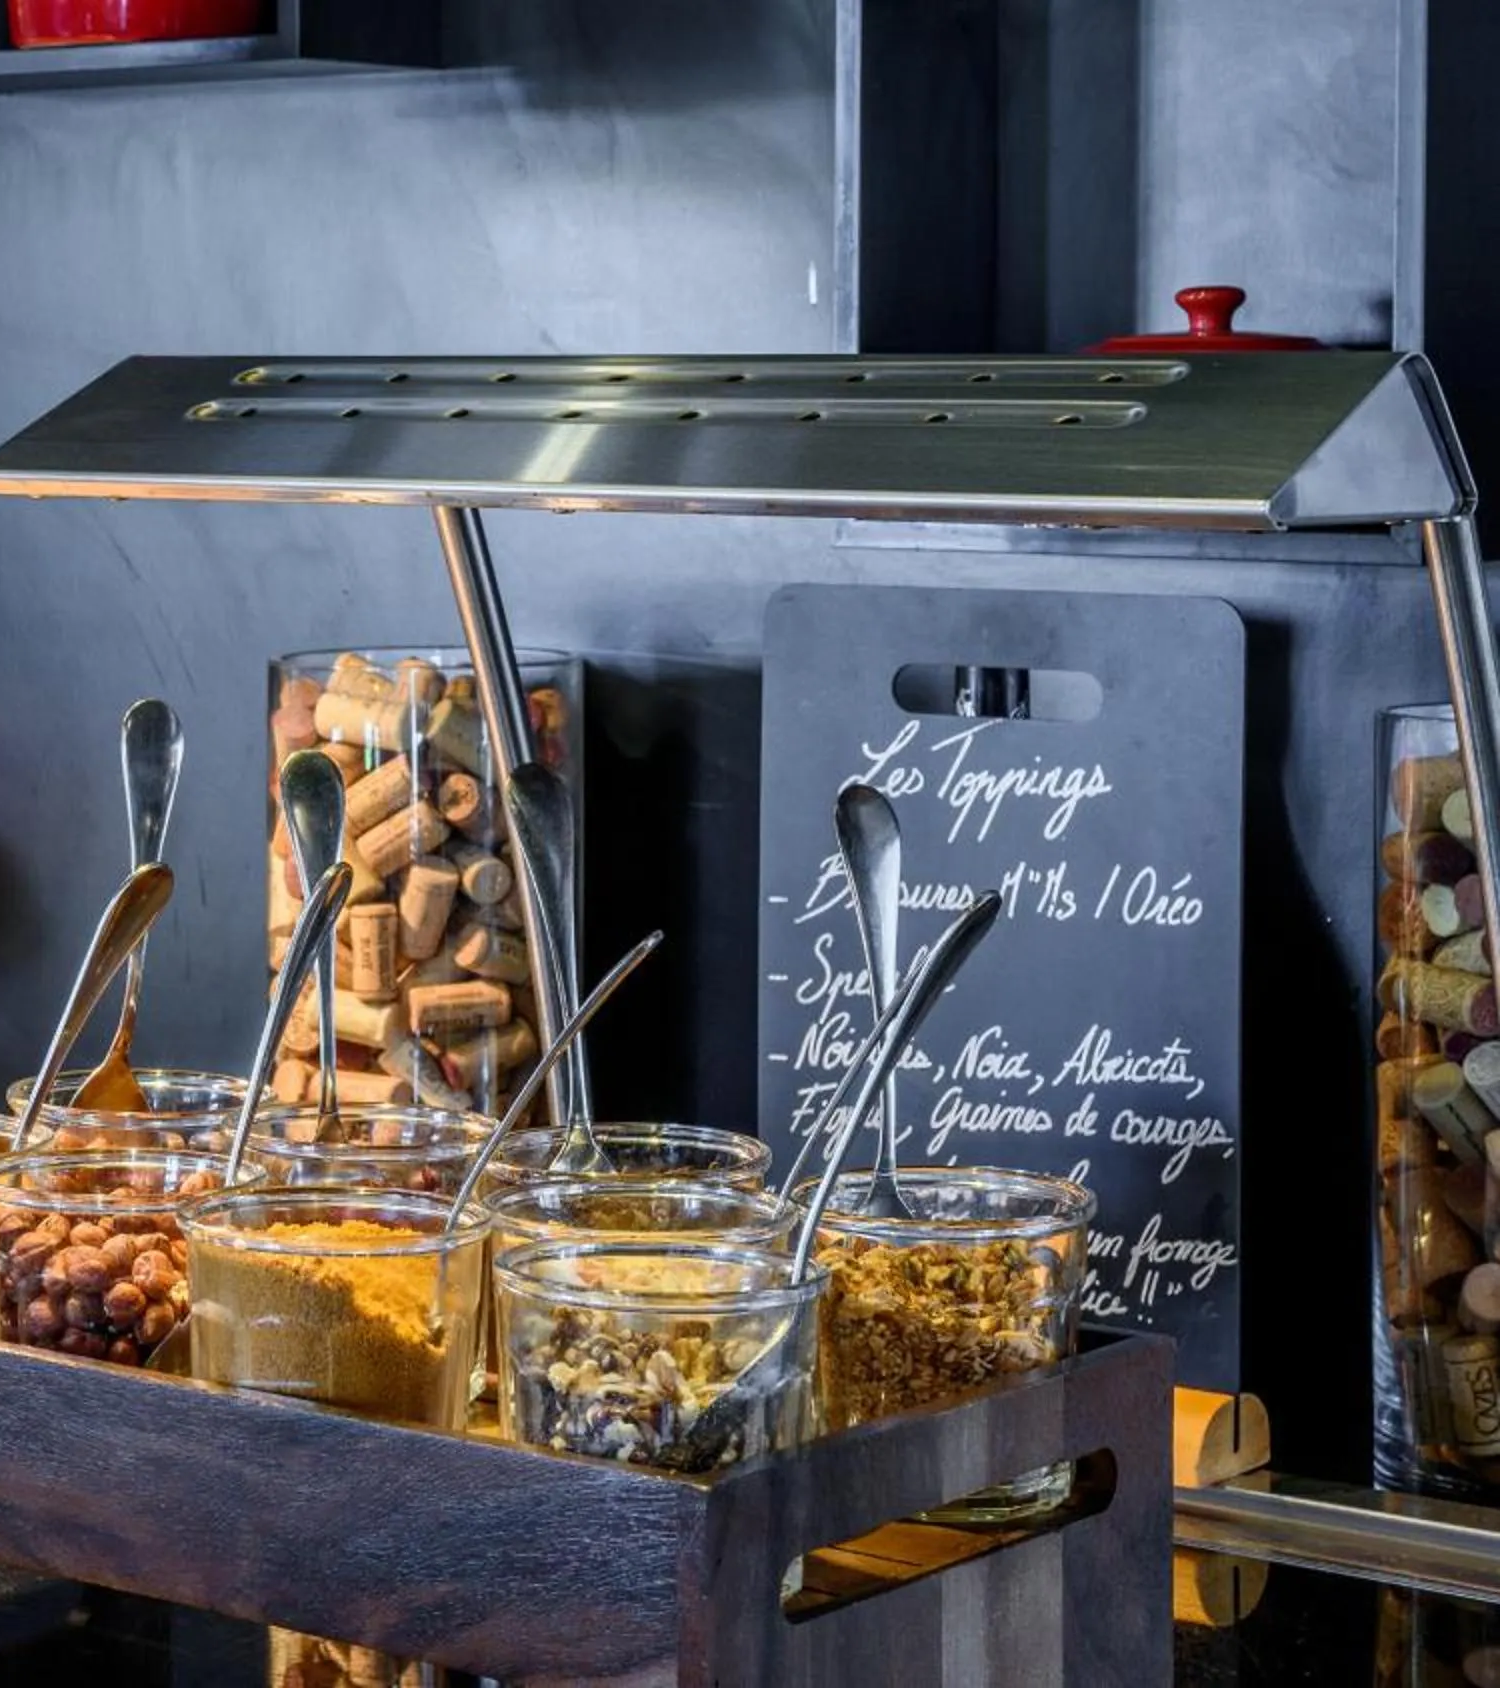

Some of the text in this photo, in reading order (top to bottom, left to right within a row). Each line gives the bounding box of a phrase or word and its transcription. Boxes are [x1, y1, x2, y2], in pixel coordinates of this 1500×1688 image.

[837, 717, 1112, 844] Les Toppings
[926, 1086, 1053, 1156] Graines
[1064, 1092, 1098, 1137] de
[1123, 1213, 1238, 1290] fromage
